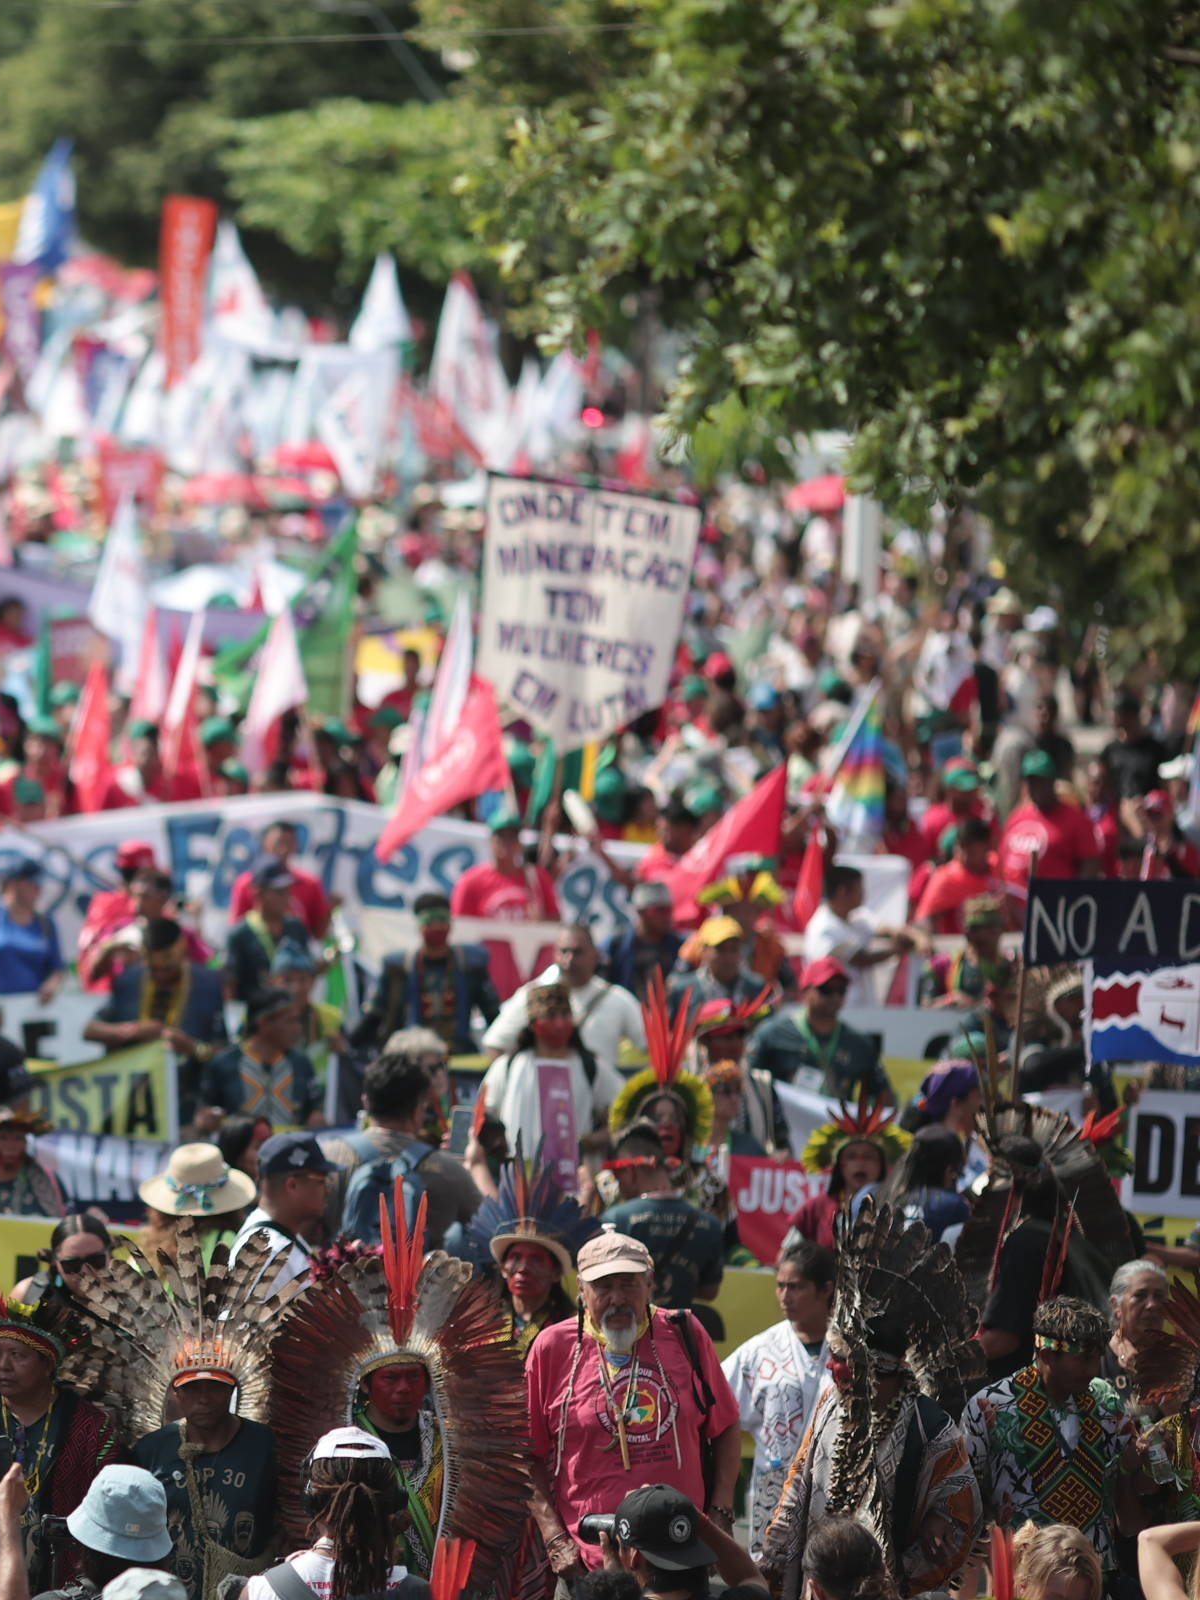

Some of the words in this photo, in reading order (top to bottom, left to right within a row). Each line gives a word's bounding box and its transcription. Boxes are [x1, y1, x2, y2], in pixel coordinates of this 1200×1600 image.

[599, 501, 672, 545] TEM
[544, 586, 606, 624] TEM
[1030, 894, 1097, 963] NO
[1118, 890, 1158, 955] A
[222, 1468, 247, 1489] 30
